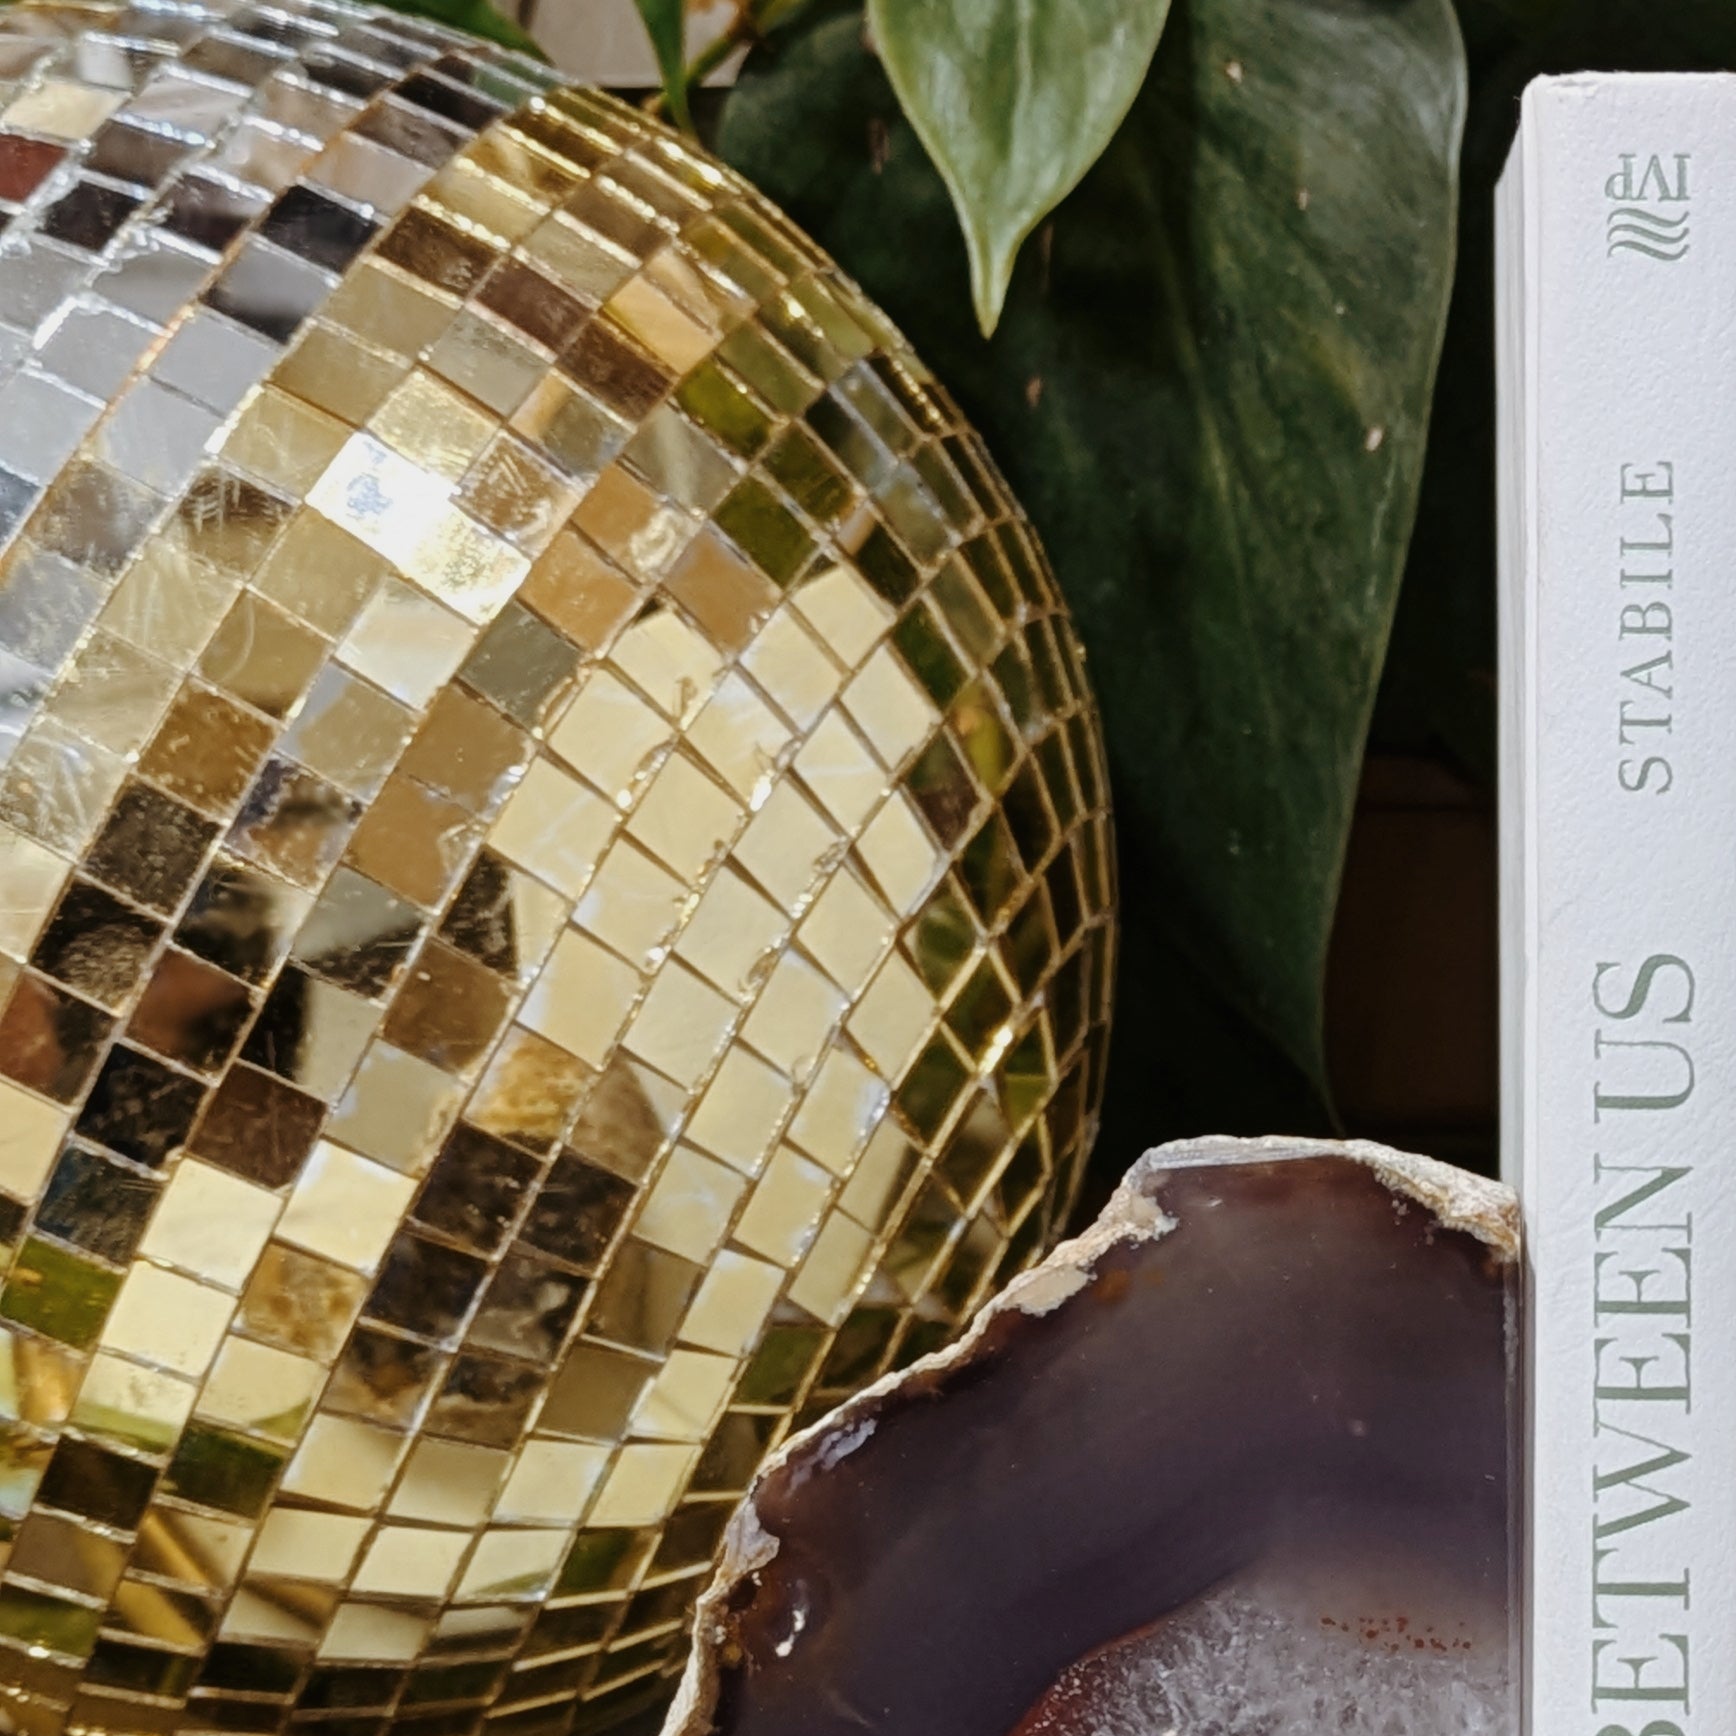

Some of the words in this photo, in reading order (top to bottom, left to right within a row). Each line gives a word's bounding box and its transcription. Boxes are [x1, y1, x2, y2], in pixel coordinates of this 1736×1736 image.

[1603, 153, 1692, 202] IVP
[1618, 459, 1675, 796] STABILE
[1591, 952, 1697, 1124] US
